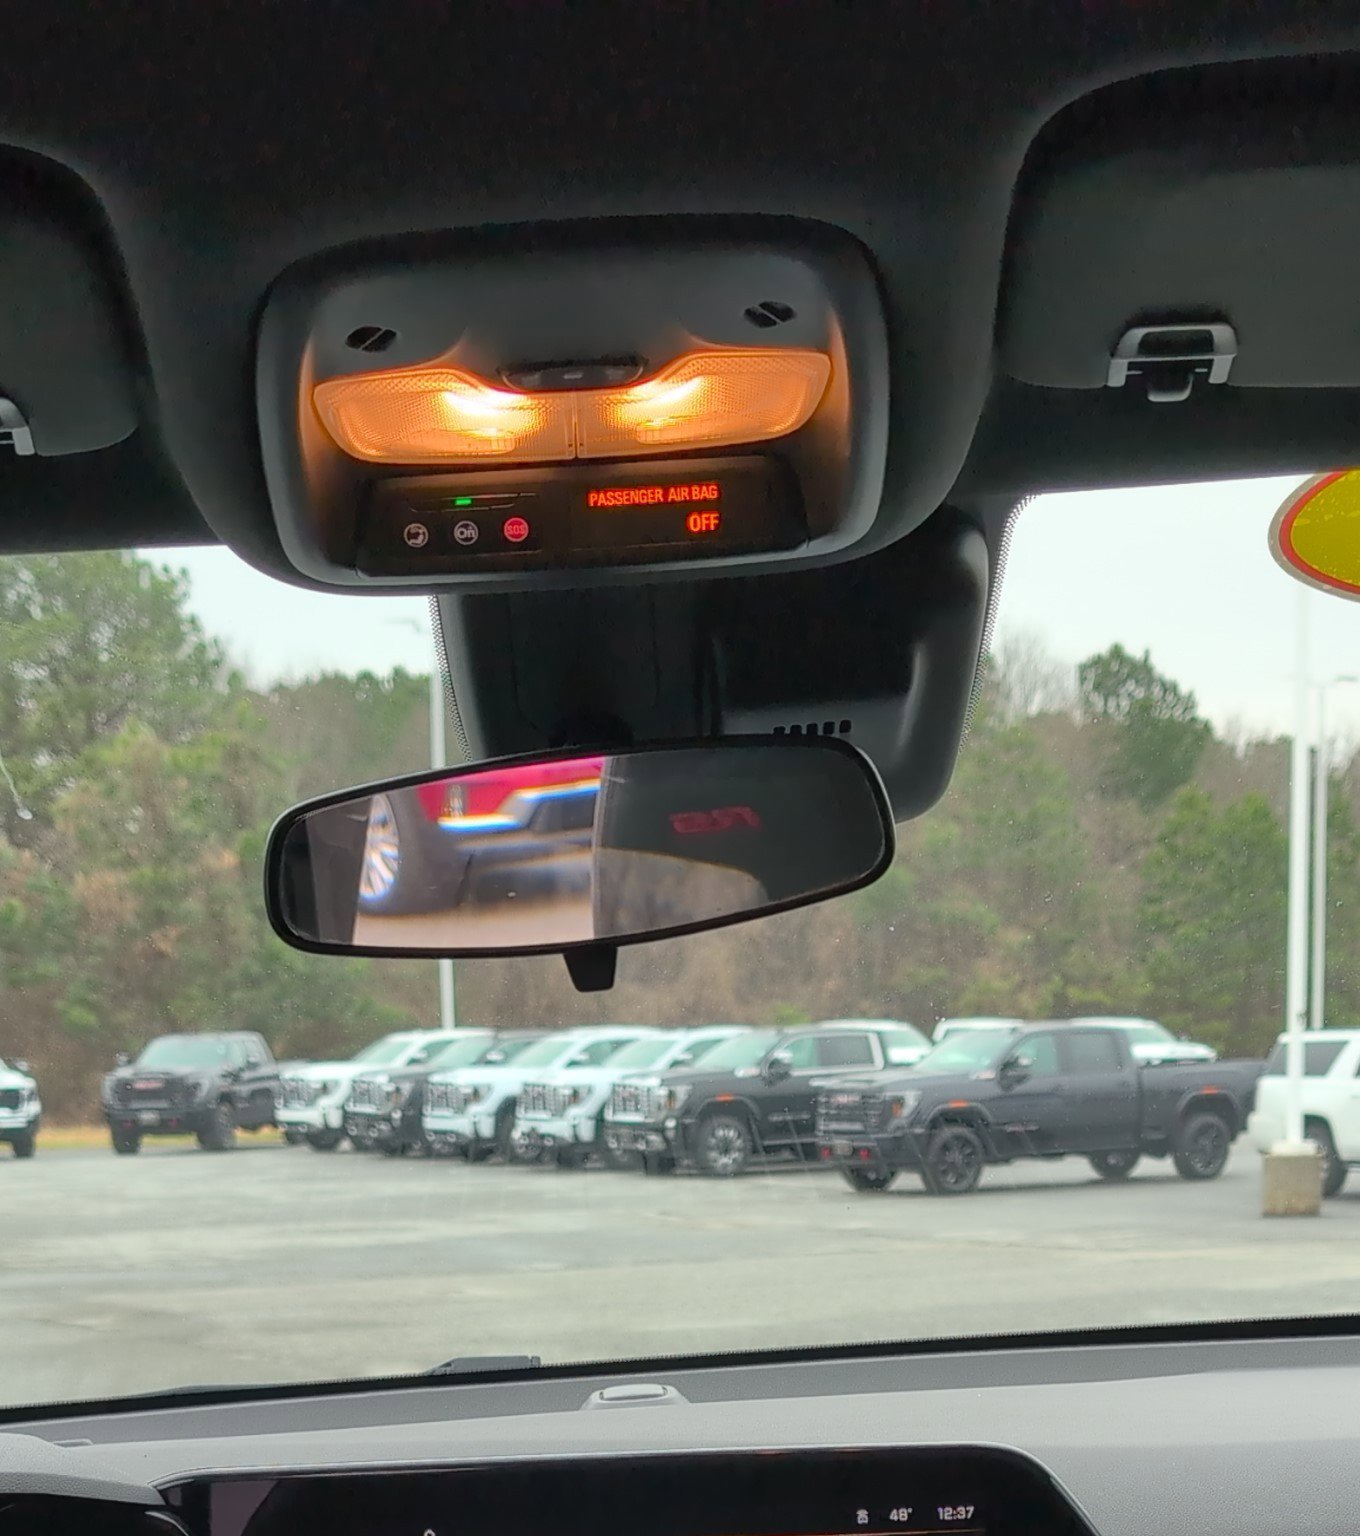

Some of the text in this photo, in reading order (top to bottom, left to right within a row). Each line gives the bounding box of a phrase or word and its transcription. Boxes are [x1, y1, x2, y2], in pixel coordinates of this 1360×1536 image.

[587, 484, 719, 507] PASSENGER AIR BAG
[506, 524, 526, 537] SOS
[688, 512, 720, 533] OFF
[937, 1506, 975, 1520] 12:37
